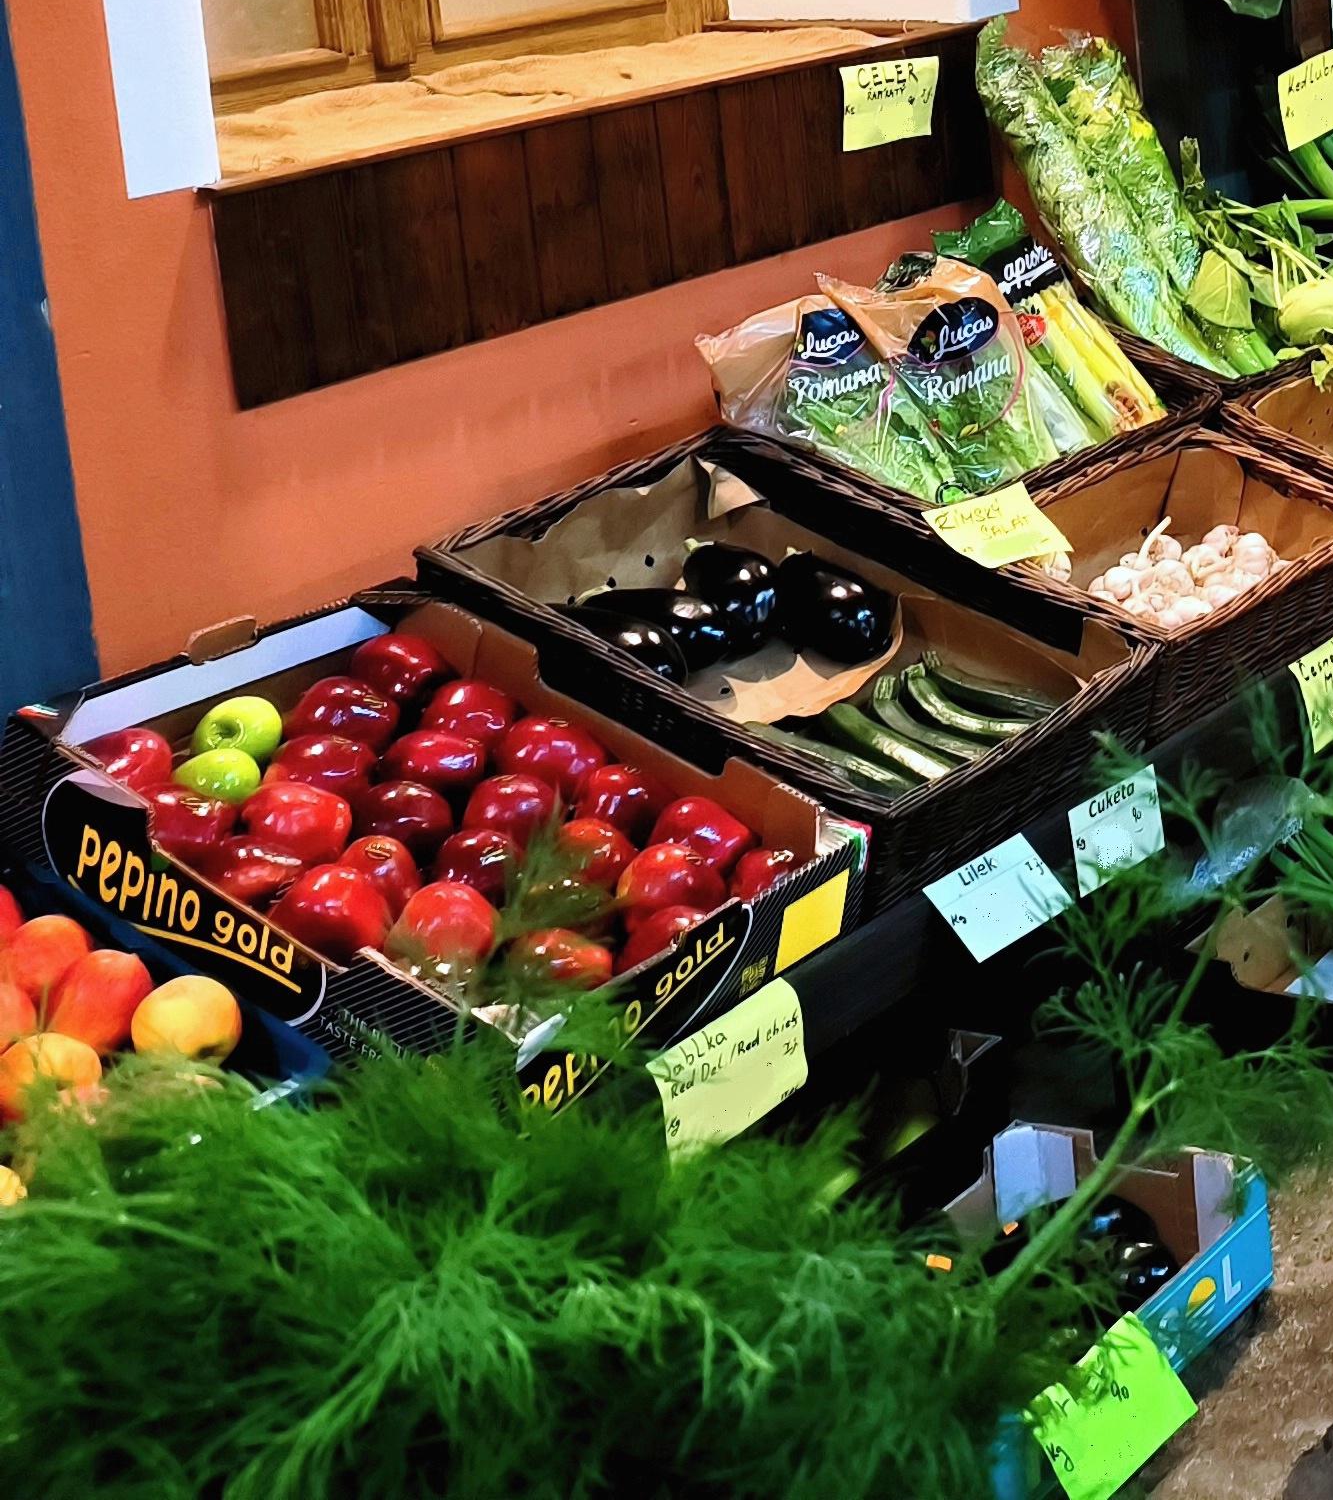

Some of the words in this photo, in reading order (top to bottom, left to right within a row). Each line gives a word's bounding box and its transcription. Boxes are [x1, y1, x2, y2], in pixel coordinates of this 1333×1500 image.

[857, 62, 919, 89] CELER
[801, 329, 860, 359] Lucas
[933, 316, 994, 360] Lucas
[789, 360, 881, 404] Romana
[922, 351, 1012, 405] Romana
[1089, 781, 1135, 818] Cuketa
[958, 856, 998, 886] Lilek
[76, 825, 200, 931] pepino
[212, 911, 294, 974] gold
[655, 922, 725, 999] gold
